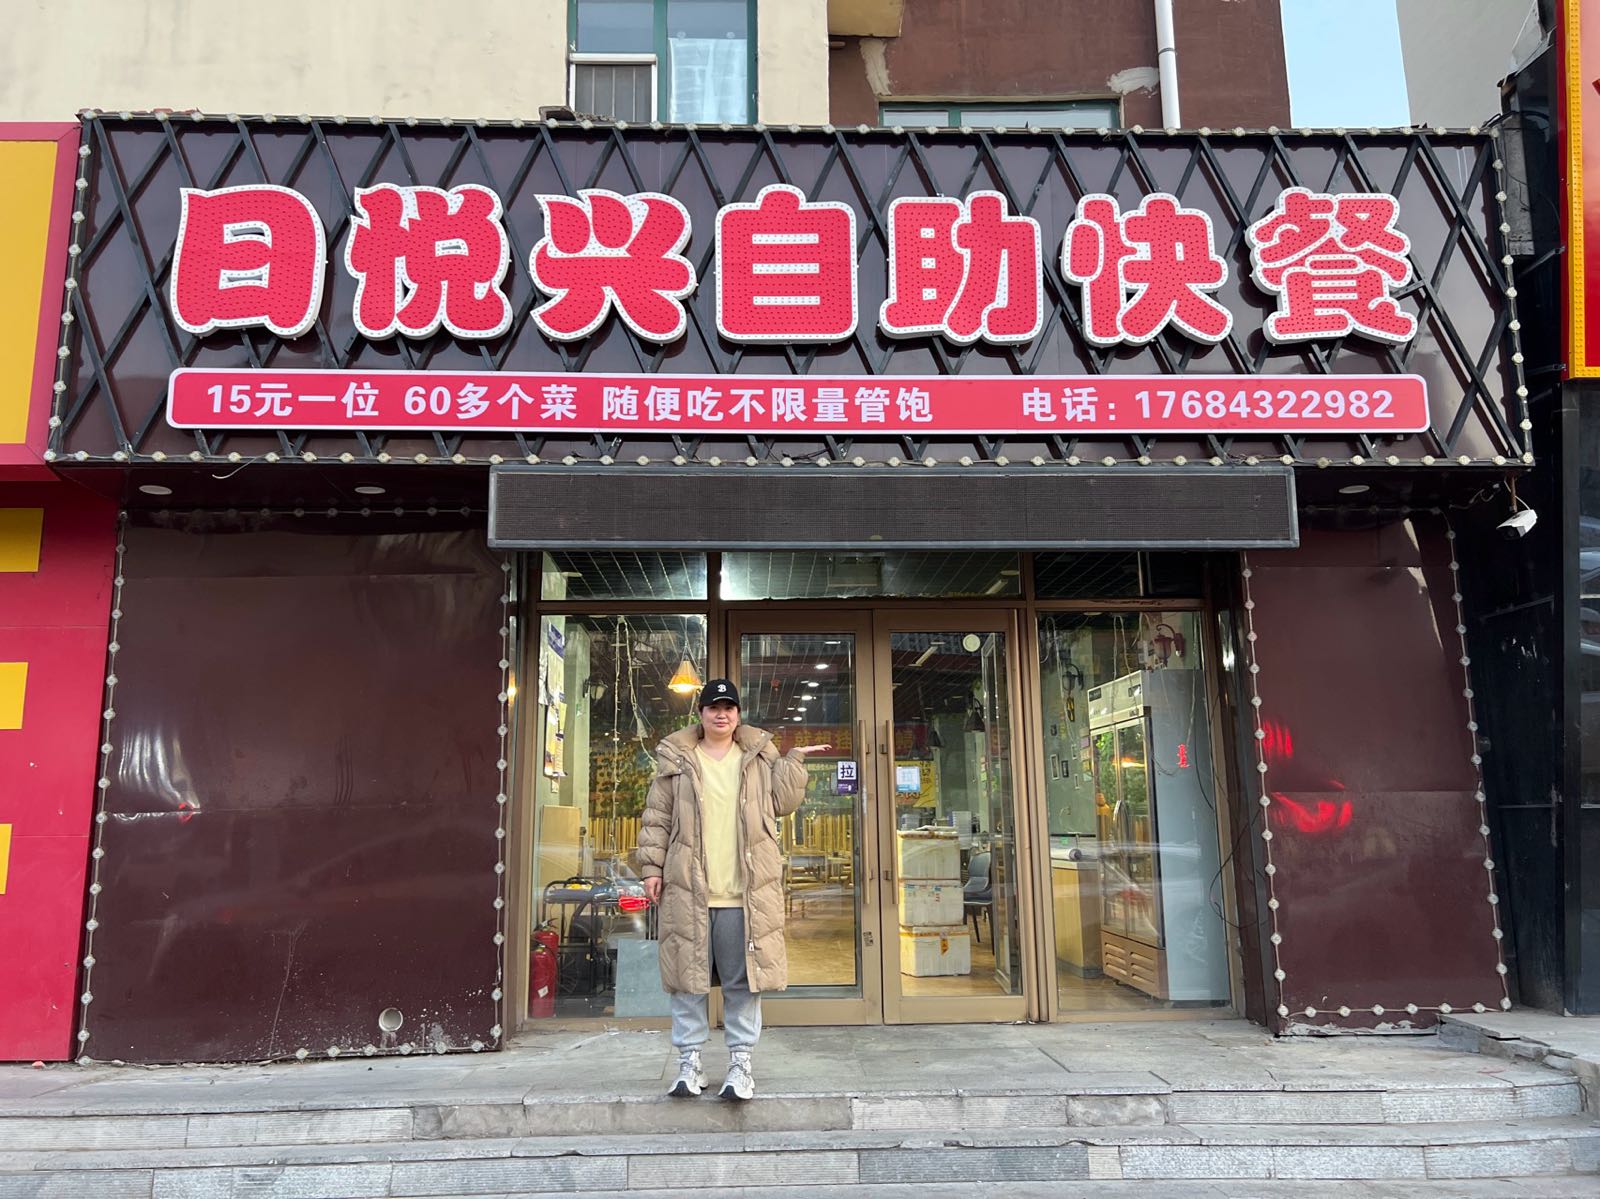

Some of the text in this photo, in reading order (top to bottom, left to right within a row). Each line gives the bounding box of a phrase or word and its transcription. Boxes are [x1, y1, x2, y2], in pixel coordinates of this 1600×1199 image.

[171, 184, 1419, 346] 日悦兴自助快餐
[207, 381, 379, 418] 15元一位
[404, 382, 577, 421] 60多个菜
[602, 386, 933, 423] 随便吃不限量管饱
[840, 764, 855, 779] 拉
